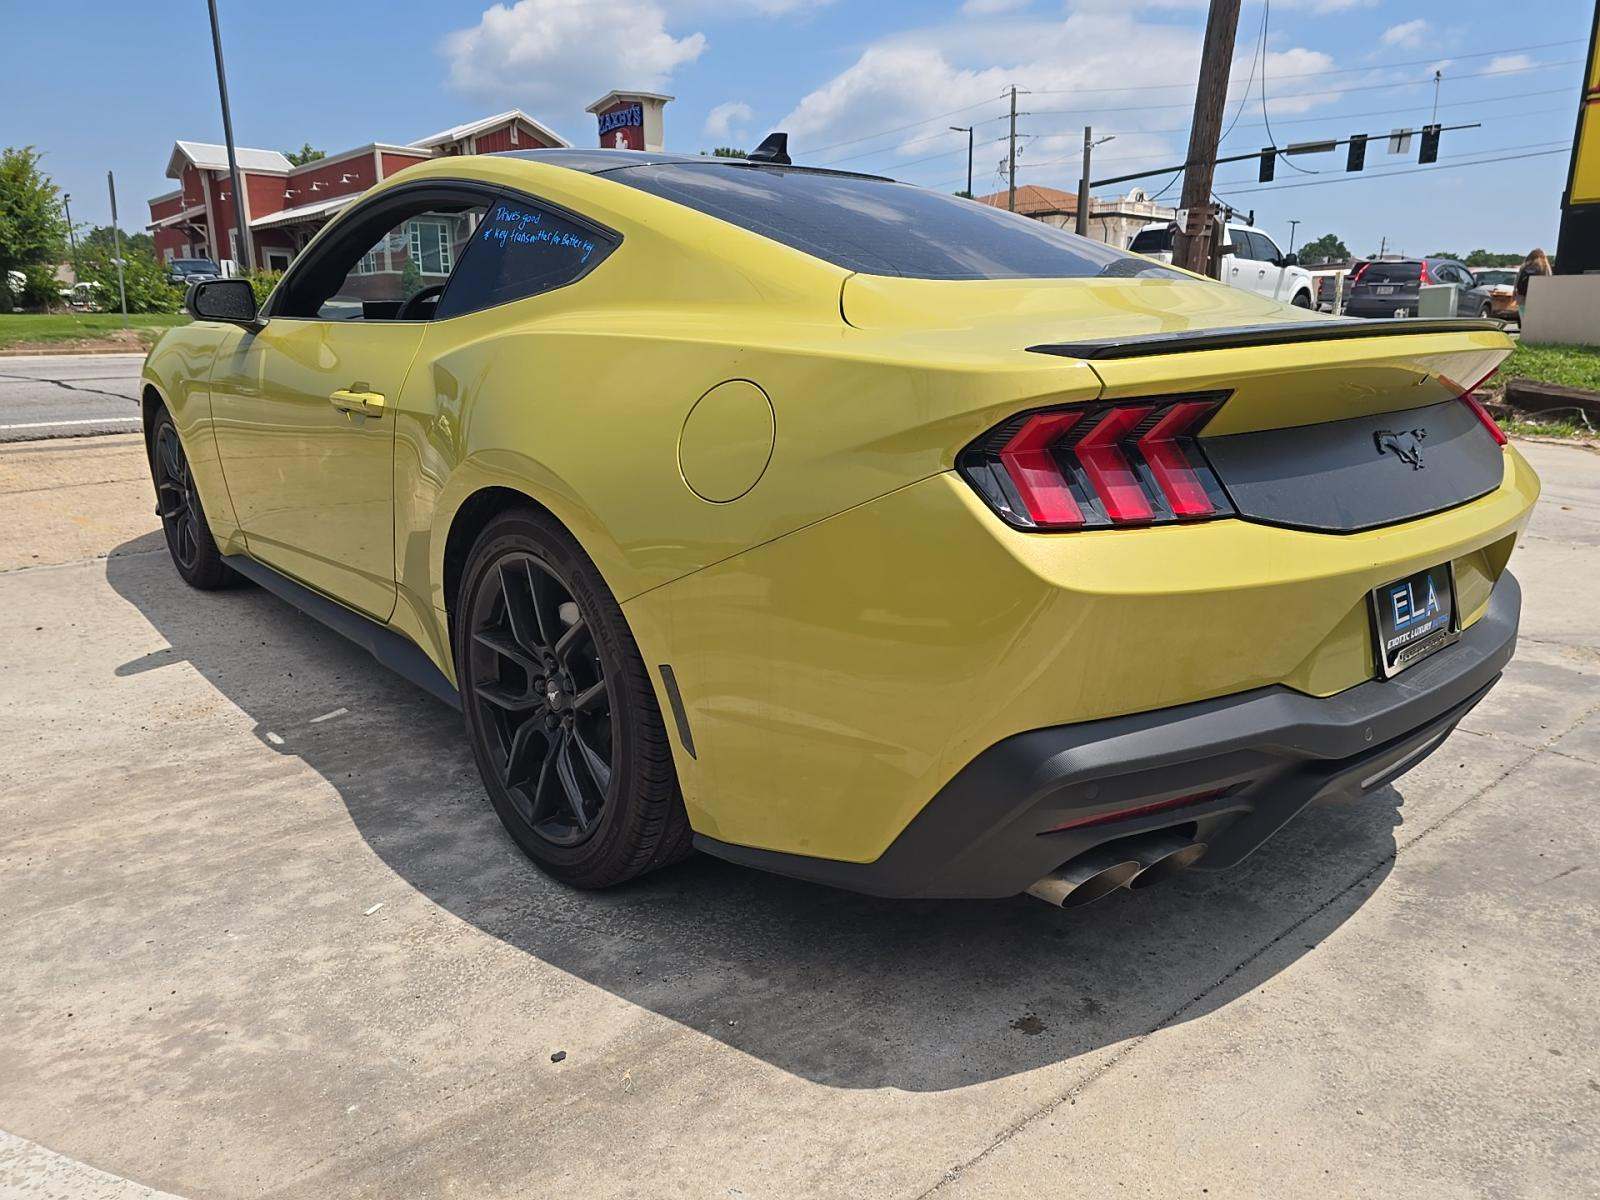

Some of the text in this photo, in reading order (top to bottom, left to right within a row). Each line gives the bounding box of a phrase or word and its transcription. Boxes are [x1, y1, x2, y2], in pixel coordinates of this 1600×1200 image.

[518, 213, 541, 230] good
[1391, 575, 1440, 630] ELA
[1387, 632, 1411, 650] EXOTIC
[1410, 621, 1433, 639] LUXURY
